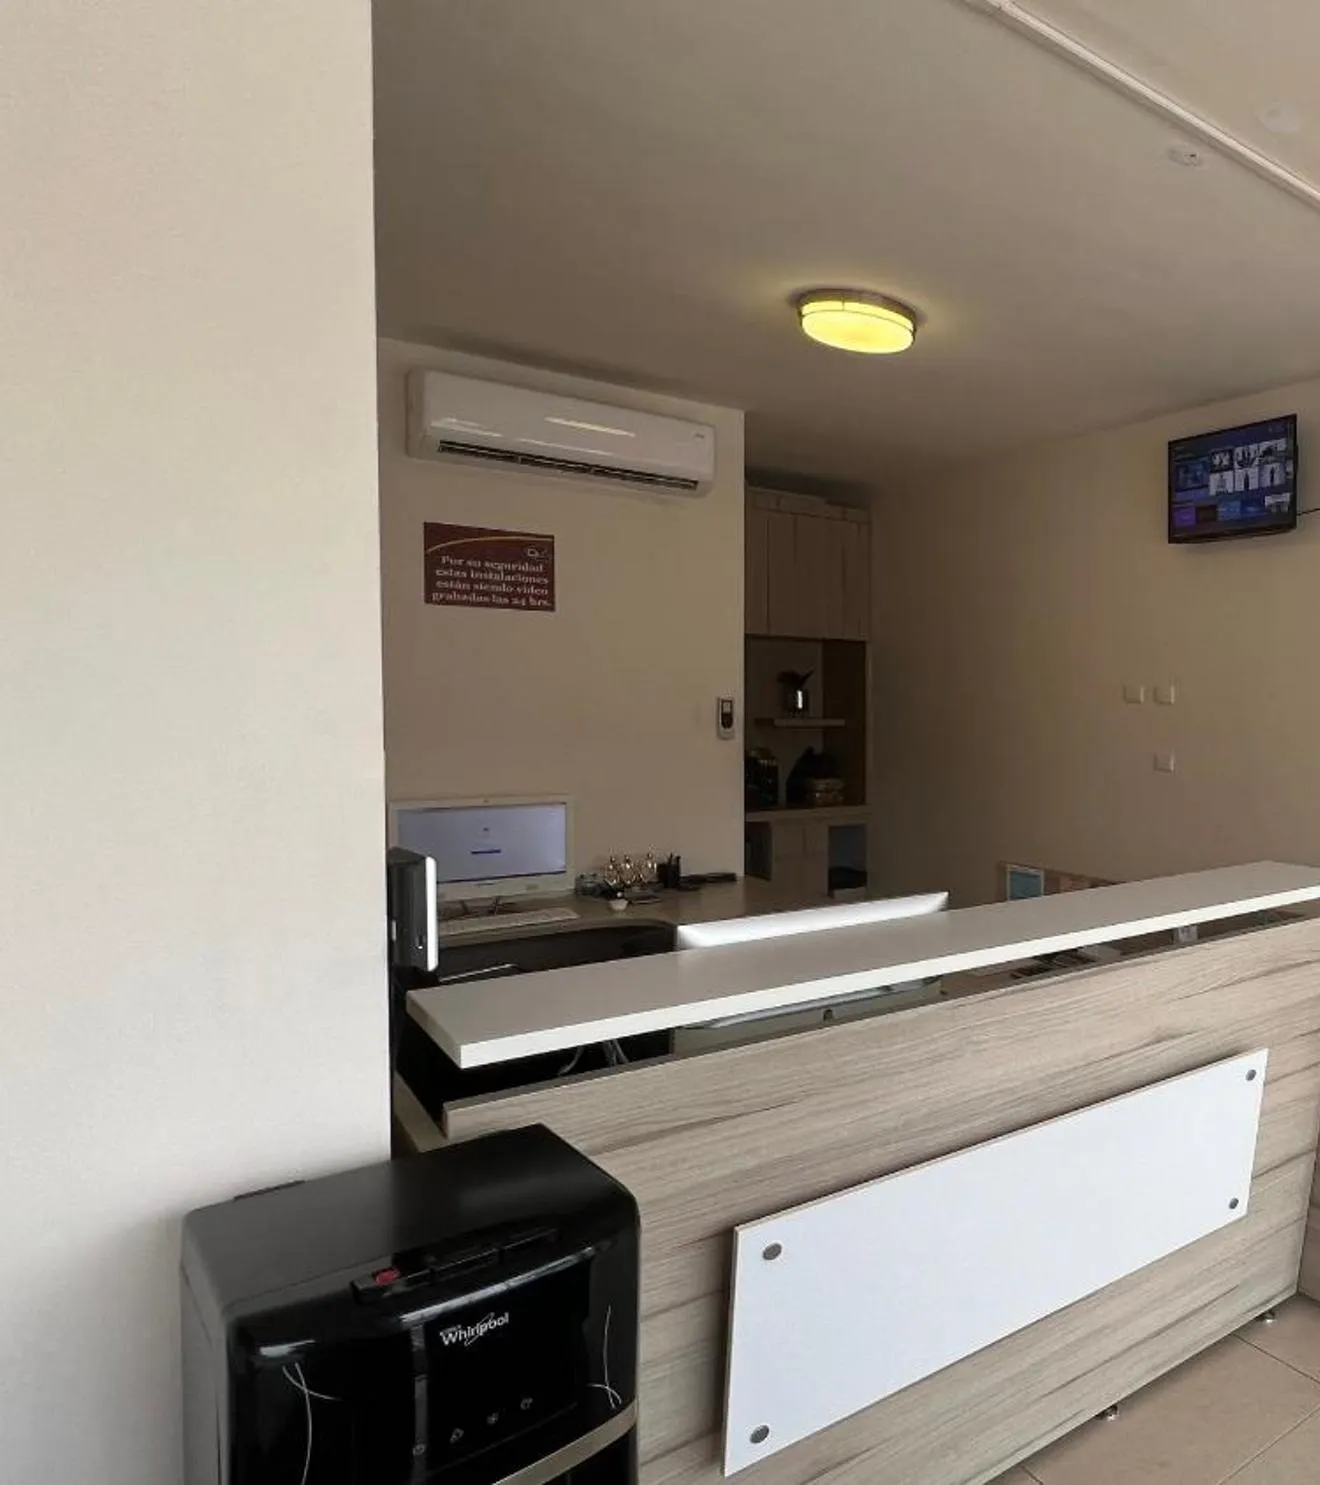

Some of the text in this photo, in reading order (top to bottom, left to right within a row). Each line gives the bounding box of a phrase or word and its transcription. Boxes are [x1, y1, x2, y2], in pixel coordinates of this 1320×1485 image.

[441, 555, 543, 573] Por su seguridad
[435, 569, 549, 584] estas instalaciones
[473, 582, 514, 592] siendo
[516, 584, 548, 595] video
[432, 591, 489, 602] grabadas
[492, 594, 510, 604] las
[440, 1311, 510, 1346] Whirlpool
